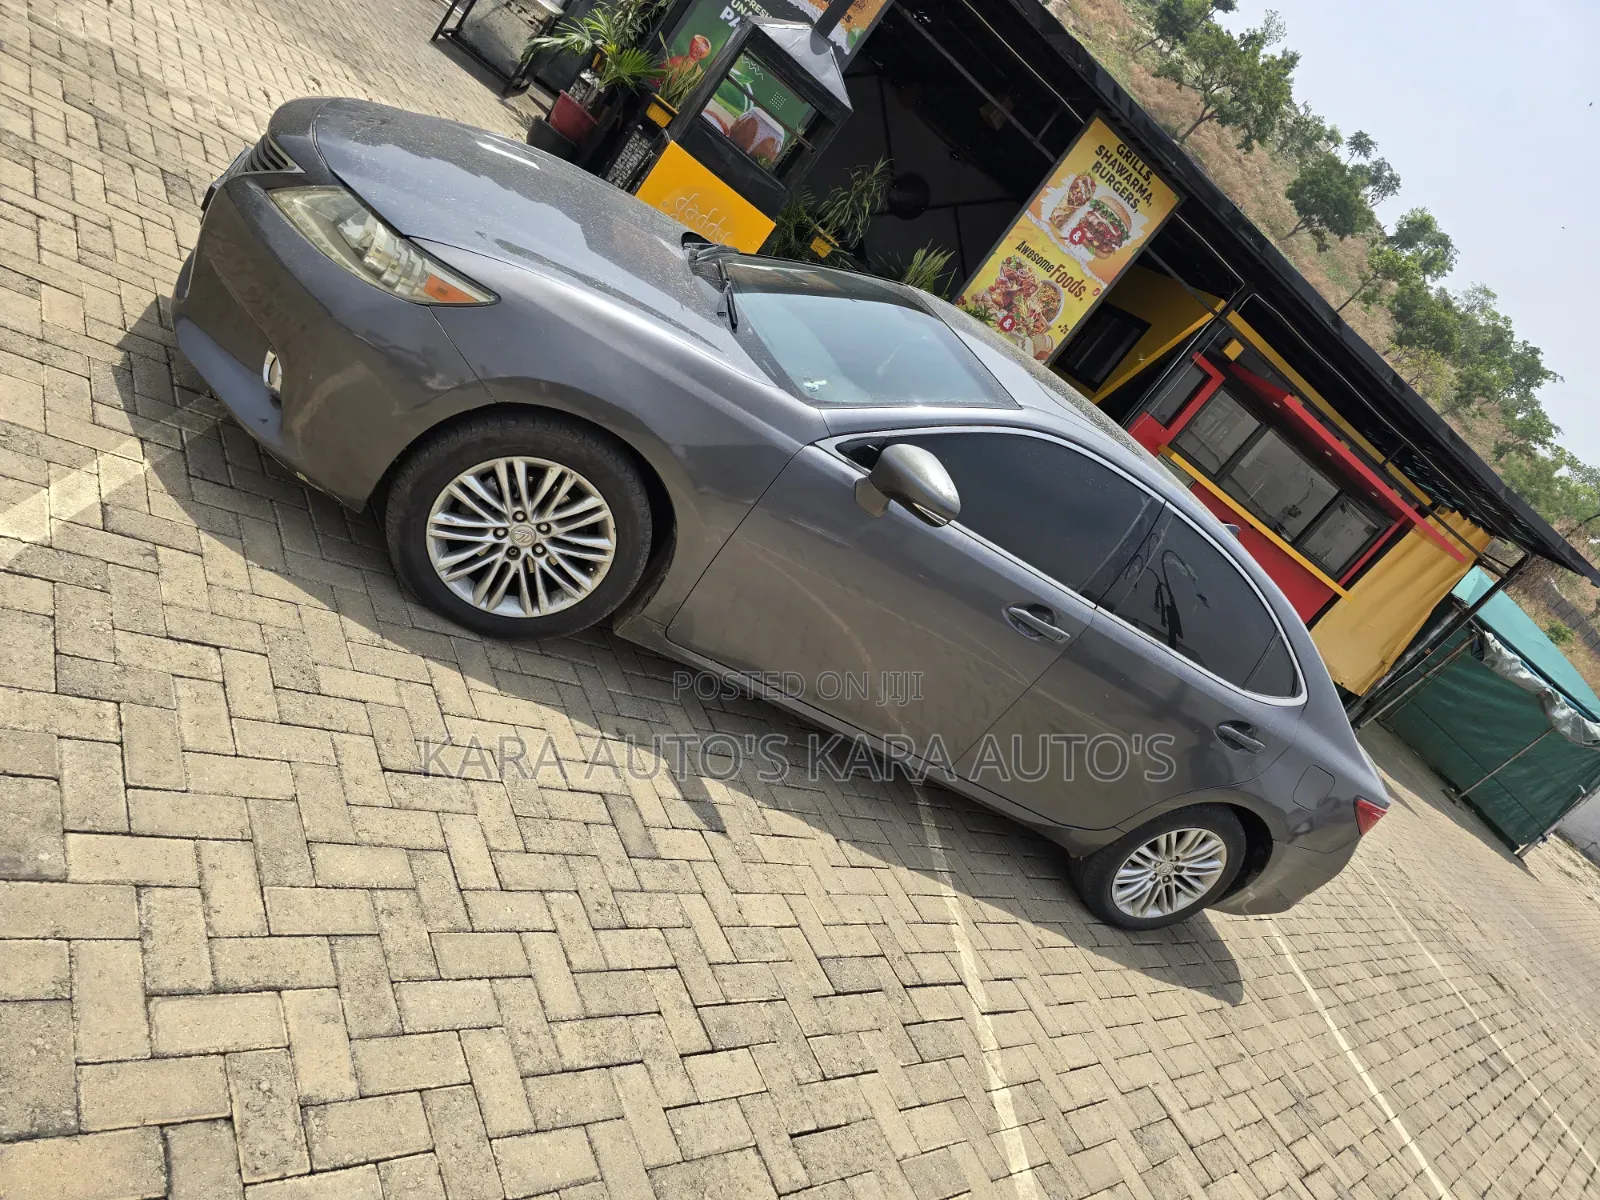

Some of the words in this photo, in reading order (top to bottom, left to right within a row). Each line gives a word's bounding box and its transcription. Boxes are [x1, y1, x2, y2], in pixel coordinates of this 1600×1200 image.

[1091, 160, 1140, 213] BURGERS,
[1095, 144, 1153, 207] SHAWARMA,
[1116, 143, 1153, 186] GRILLS,
[1015, 240, 1055, 272] Awesome
[1048, 264, 1087, 302] Foods.
